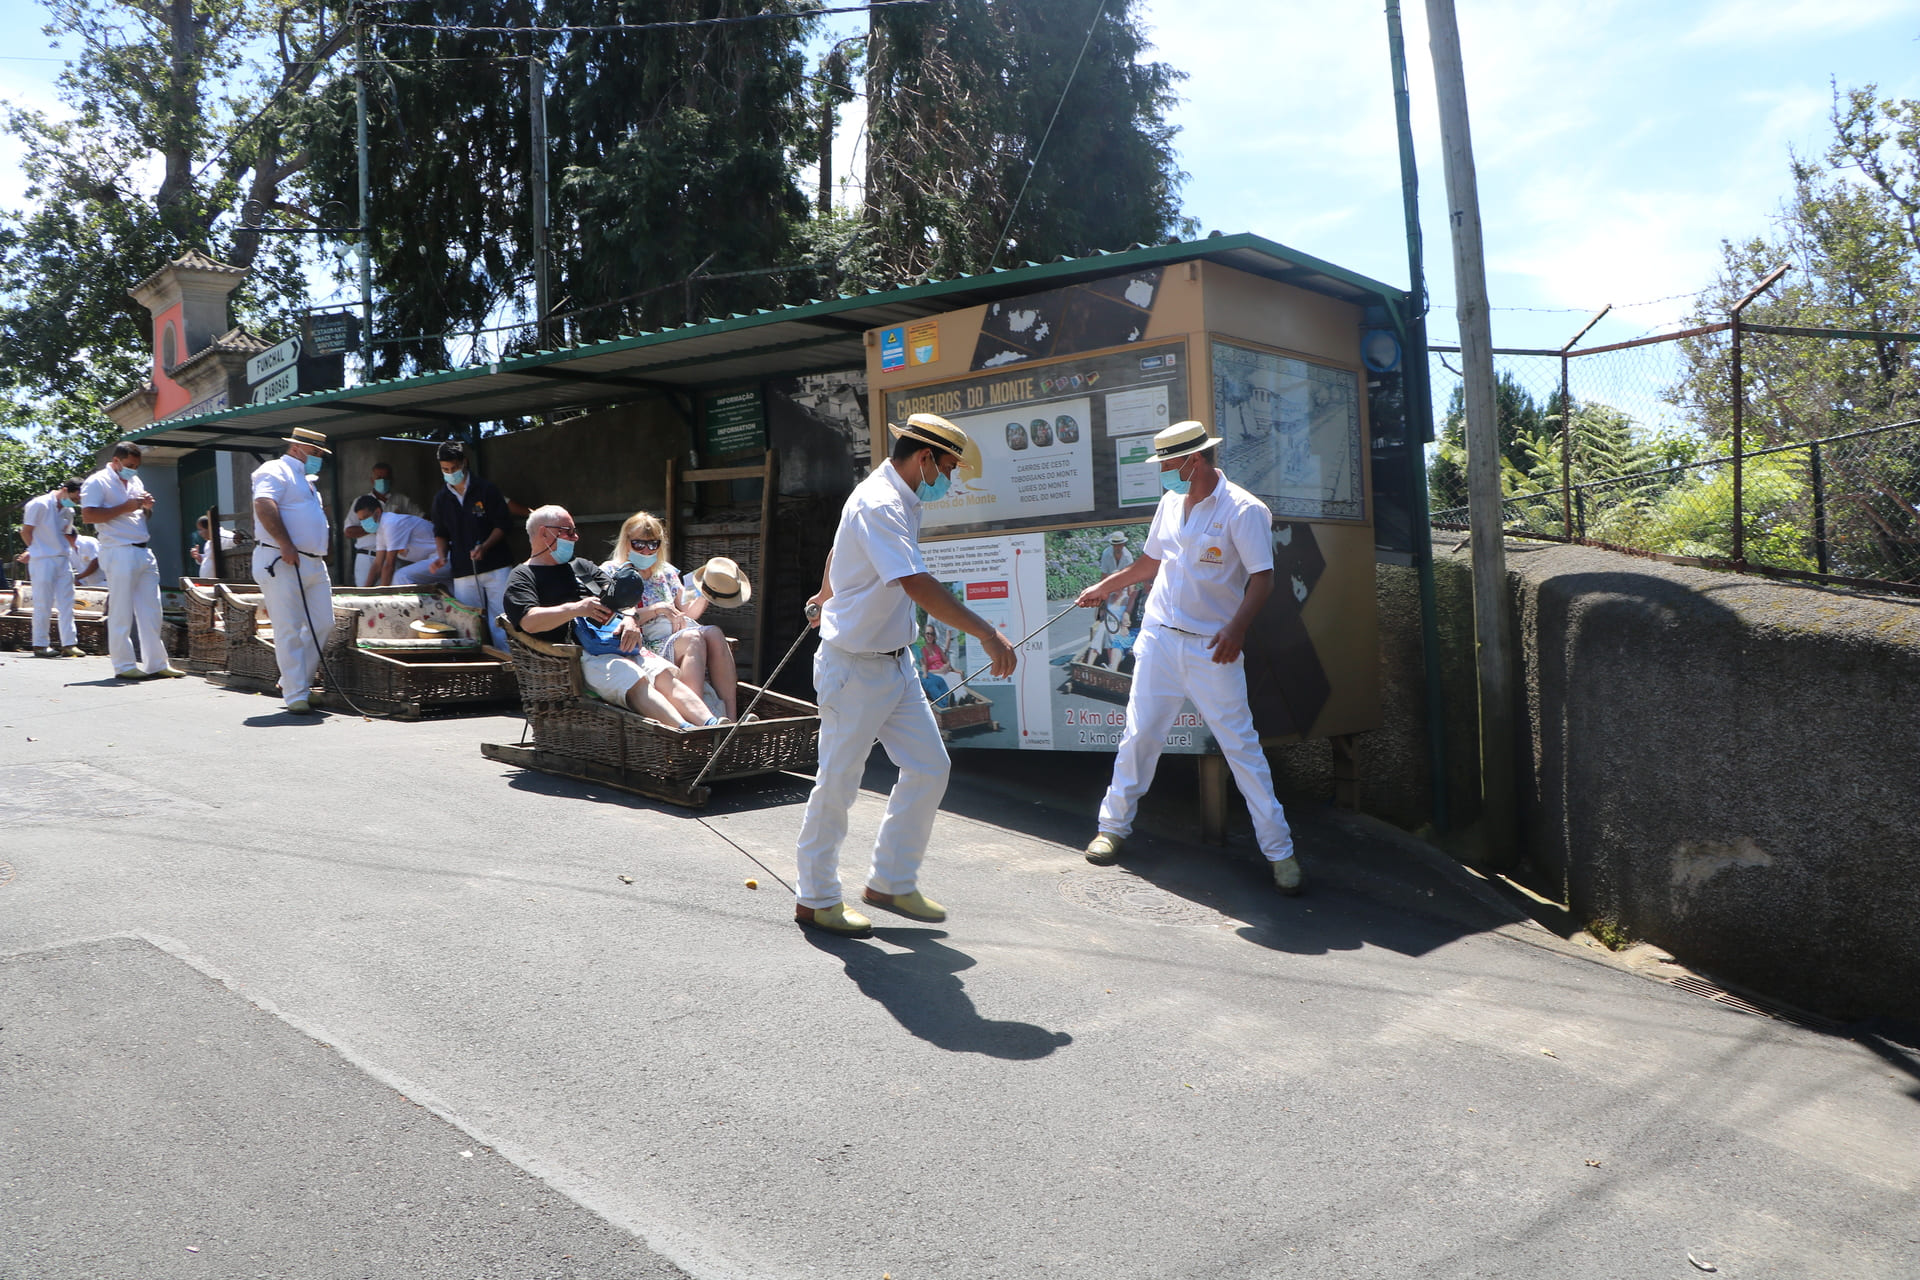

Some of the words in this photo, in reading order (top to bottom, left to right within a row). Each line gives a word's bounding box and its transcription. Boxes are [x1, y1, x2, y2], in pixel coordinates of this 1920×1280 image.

[257, 348, 284, 375] FUNCHAL
[264, 374, 289, 402] BABOSAS
[896, 390, 962, 421] CARREIROS
[967, 386, 984, 409] DO
[989, 377, 1034, 405] MONTE
[717, 423, 756, 435] INFORMATION
[1017, 463, 1040, 472] CARROS
[1041, 462, 1050, 470] DE
[1051, 460, 1070, 468] CESTO
[1057, 469, 1078, 478] MONTE
[1048, 481, 1069, 489] MONTE
[1050, 491, 1071, 499] MONTE
[924, 500, 950, 511] reiros
[952, 496, 964, 507] do
[966, 494, 997, 506] Monte
[1025, 641, 1031, 651] 2
[1032, 641, 1043, 651] KM
[1065, 709, 1074, 726] 2
[1079, 710, 1101, 726] Km
[1106, 711, 1125, 726] de
[1079, 731, 1086, 743] 2
[1090, 732, 1106, 743] km
[1110, 732, 1122, 744] of
